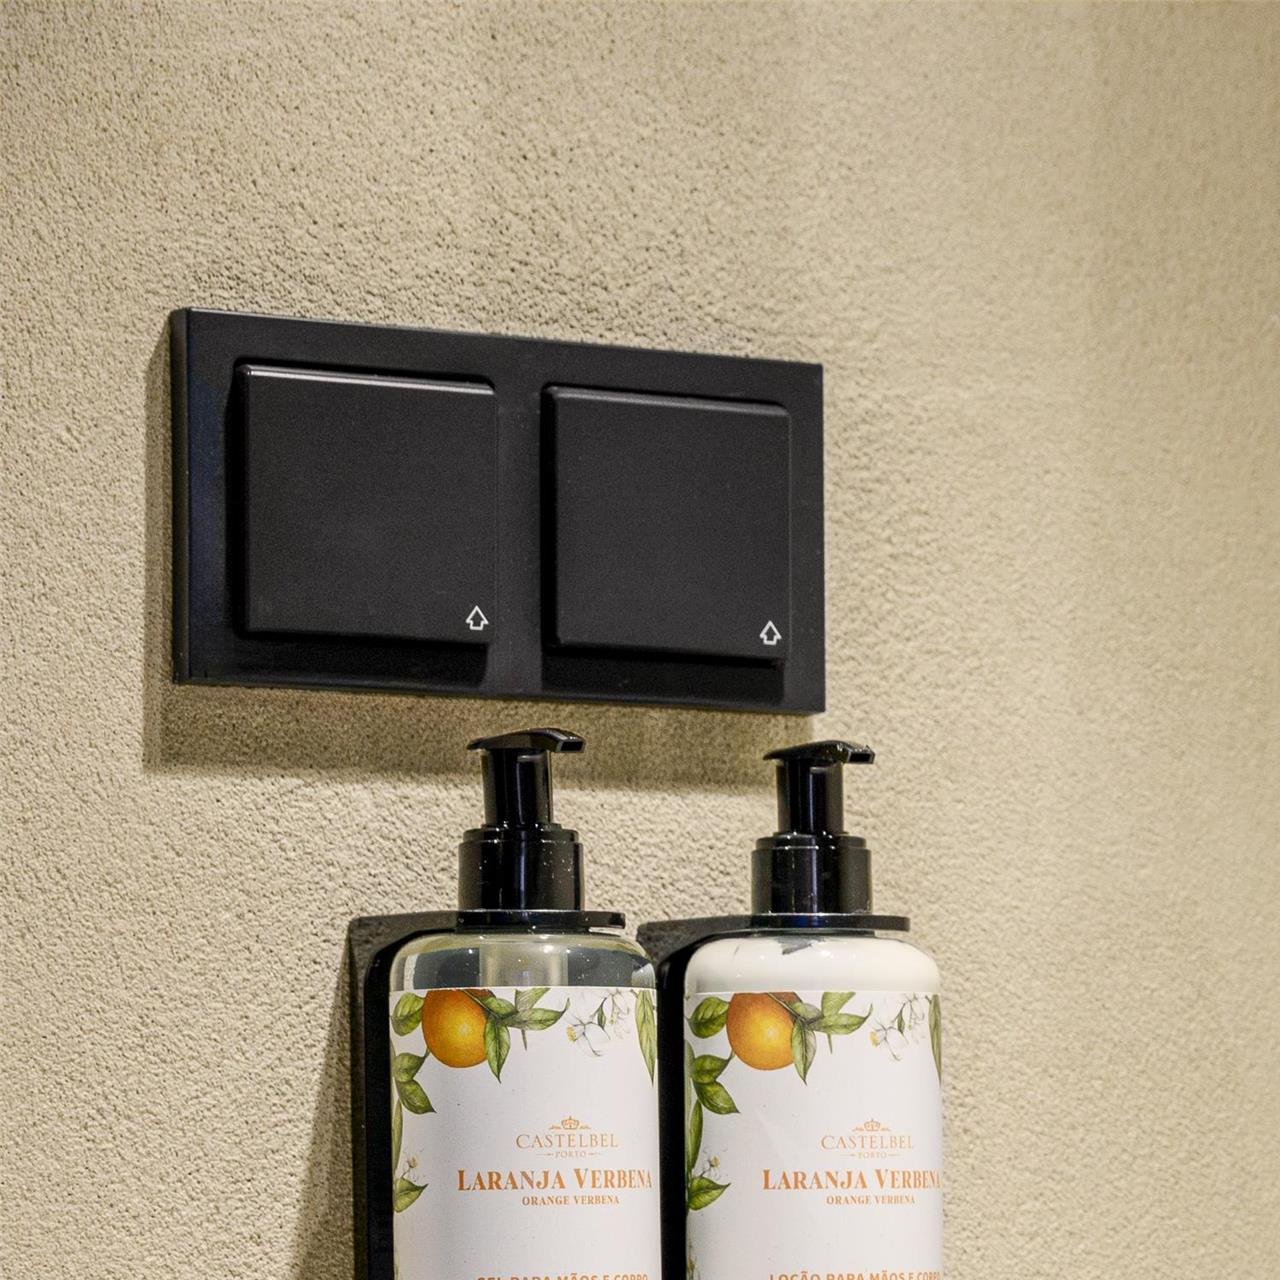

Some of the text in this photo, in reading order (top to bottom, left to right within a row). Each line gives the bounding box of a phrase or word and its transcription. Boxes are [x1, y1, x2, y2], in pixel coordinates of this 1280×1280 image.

[516, 1134, 618, 1149] CASTELBEL
[821, 1136, 914, 1150] CASTELBEL
[457, 1168, 652, 1191] LARANJA VERBENA
[762, 1169, 867, 1190] LARANJA
[522, 1195, 620, 1206] ORANGE VERBENA
[826, 1195, 915, 1205] ORANGE VERBENA
